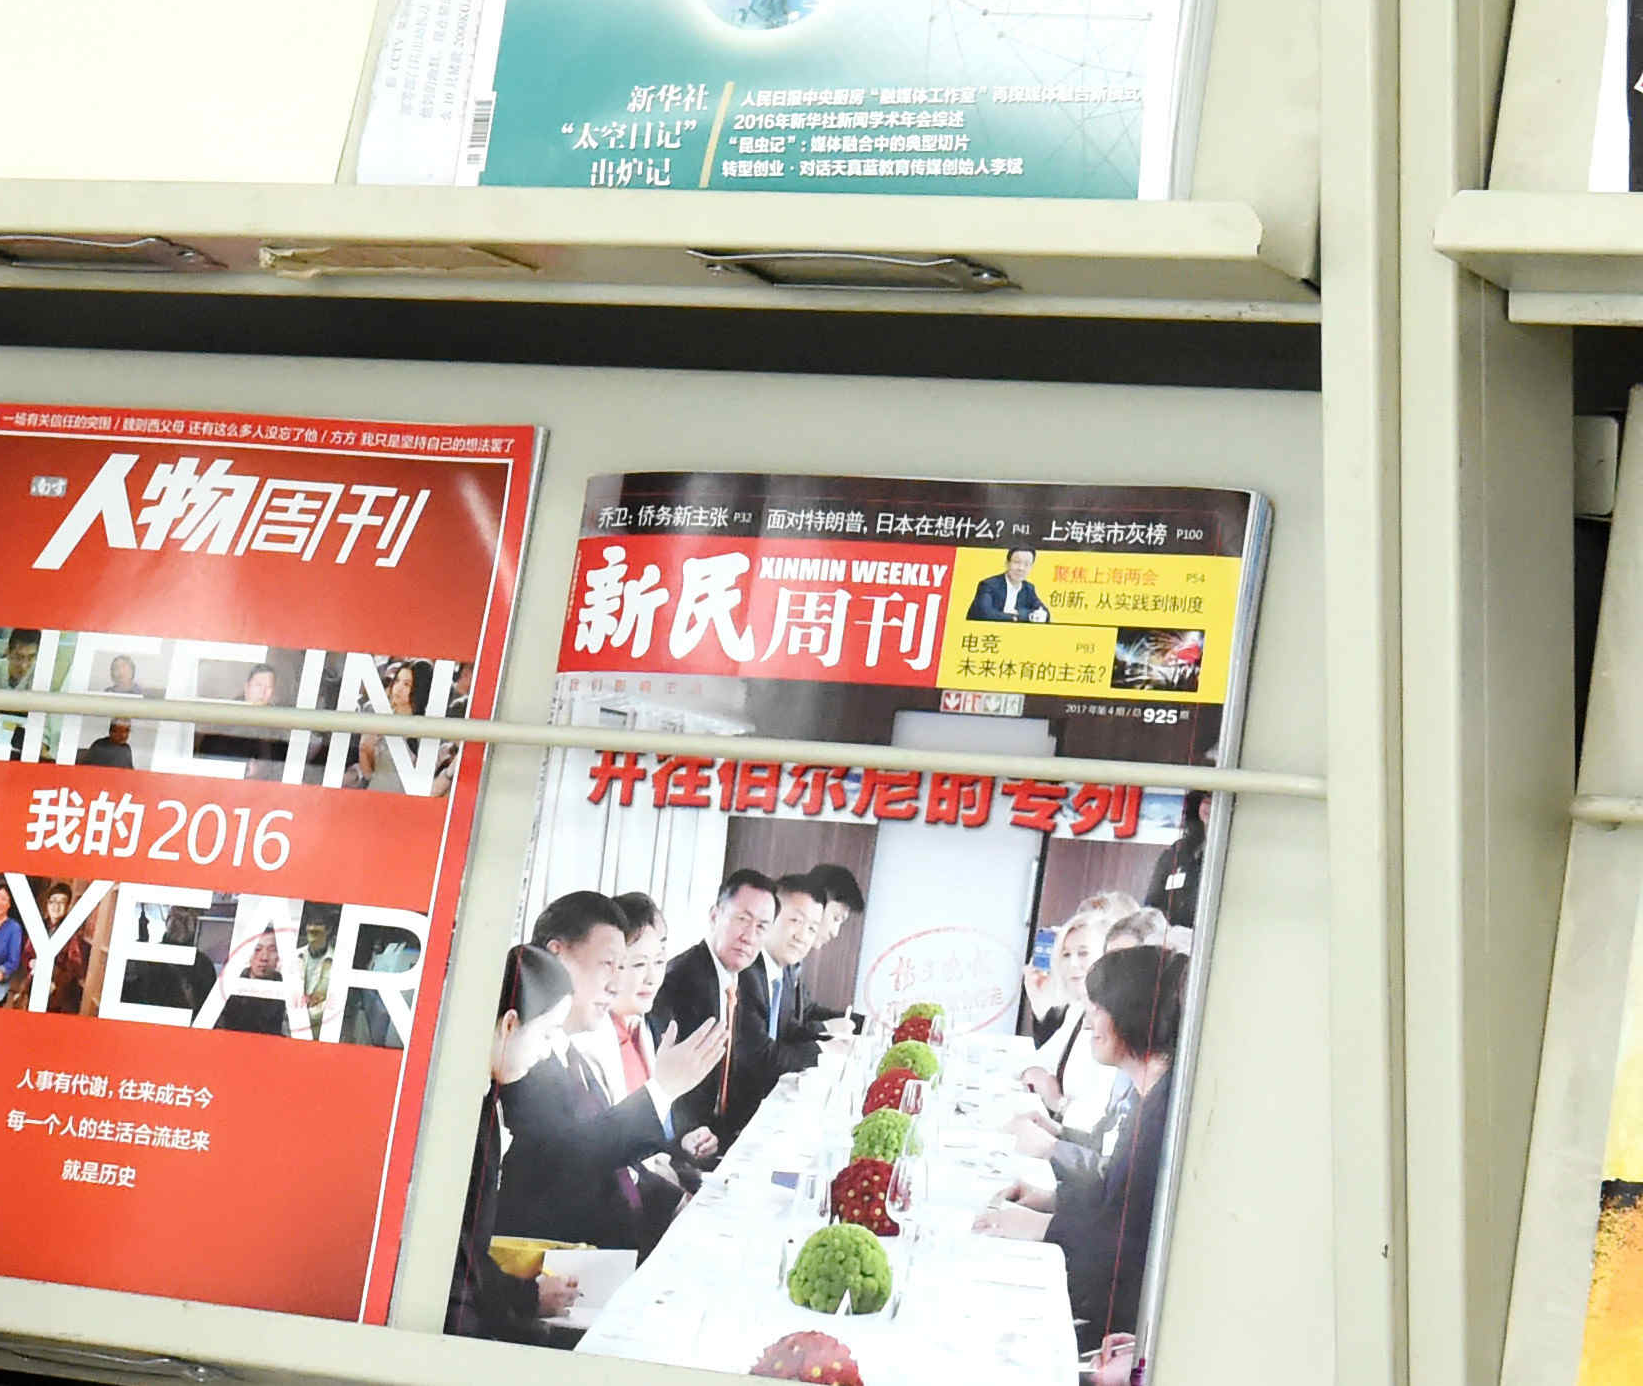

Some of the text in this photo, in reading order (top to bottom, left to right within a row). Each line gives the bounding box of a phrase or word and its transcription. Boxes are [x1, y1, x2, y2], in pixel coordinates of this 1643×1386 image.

[626, 83, 711, 116] 新华社
[733, 110, 965, 132] 2016年新华社新闻学术年会综述
[588, 157, 673, 190] 出炉记
[330, 430, 357, 446] 方方
[32, 452, 431, 570] 人物周刊
[1042, 518, 1168, 546] 上海楼市灰榜
[1176, 527, 1205, 542] P100
[759, 555, 948, 588] XINMIN WEEKLY
[1051, 563, 1160, 588] 聚焦上海两会
[575, 544, 944, 672] 新民周刊
[960, 632, 1002, 655] 电竞
[281, 649, 456, 798] IN
[25, 787, 295, 872] 我的2016
[4, 872, 428, 1047] YEAR
[6, 1109, 211, 1154] 每一个人的生活合流起来
[61, 1157, 137, 1188] 就是历史
